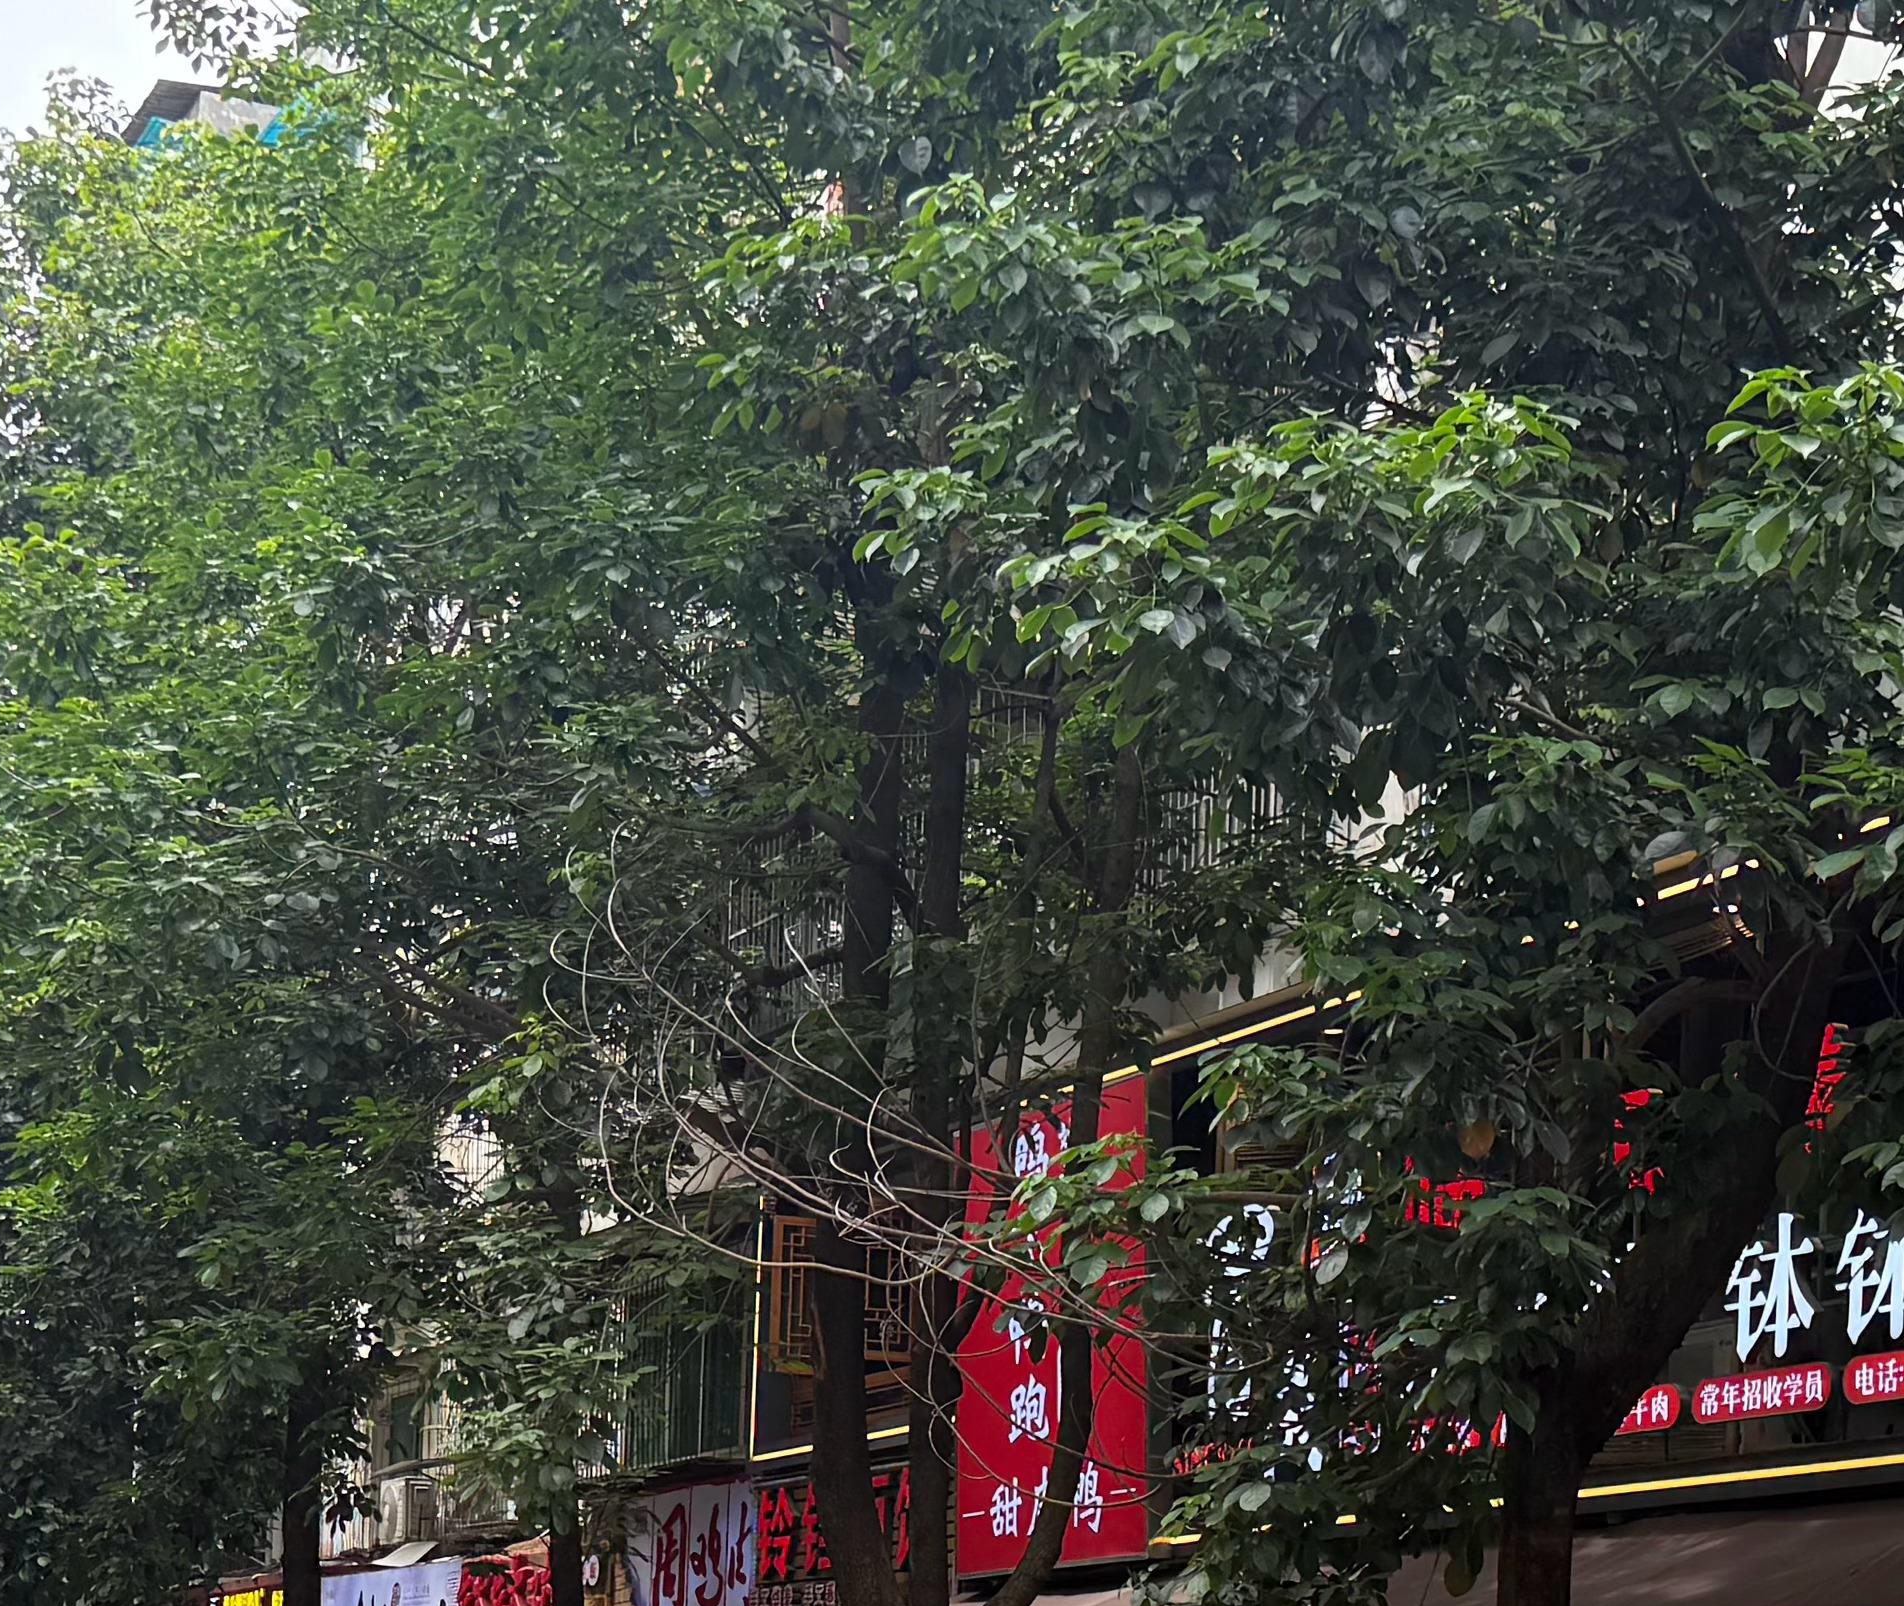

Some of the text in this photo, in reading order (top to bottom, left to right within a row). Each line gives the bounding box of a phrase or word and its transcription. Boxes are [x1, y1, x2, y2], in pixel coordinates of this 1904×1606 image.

[1699, 1369, 1824, 1416] 常年招收学员
